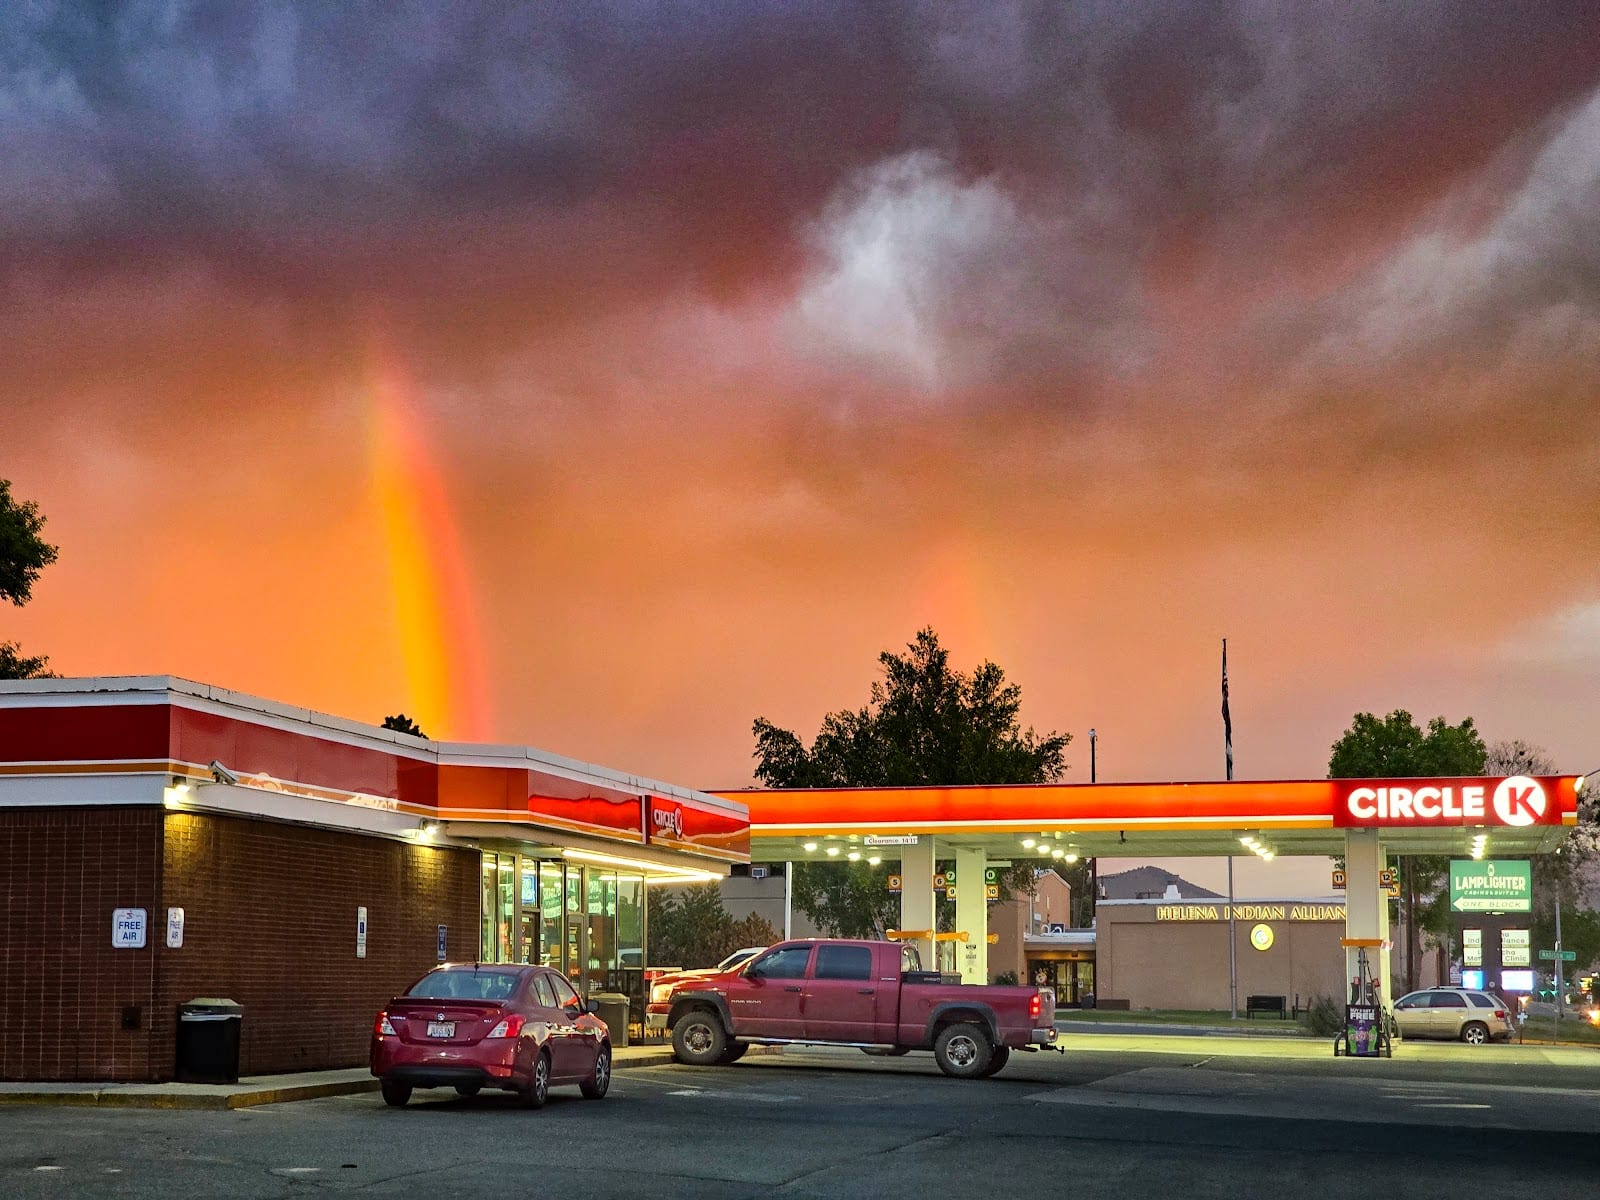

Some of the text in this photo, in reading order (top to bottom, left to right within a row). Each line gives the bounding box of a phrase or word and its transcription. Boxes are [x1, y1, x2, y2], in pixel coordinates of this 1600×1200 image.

[1347, 786, 1543, 824] CIRCLE K
[654, 809, 674, 828] CIRCLE
[1382, 873, 1391, 881] 12
[1455, 875, 1526, 891] LAMPLIGHTER
[1156, 905, 1219, 921] HELENA
[1224, 905, 1285, 921] INDIAN
[118, 921, 141, 929] FREE
[170, 920, 181, 929] FREE
[122, 931, 137, 940] AIR
[171, 931, 179, 939] AIR
